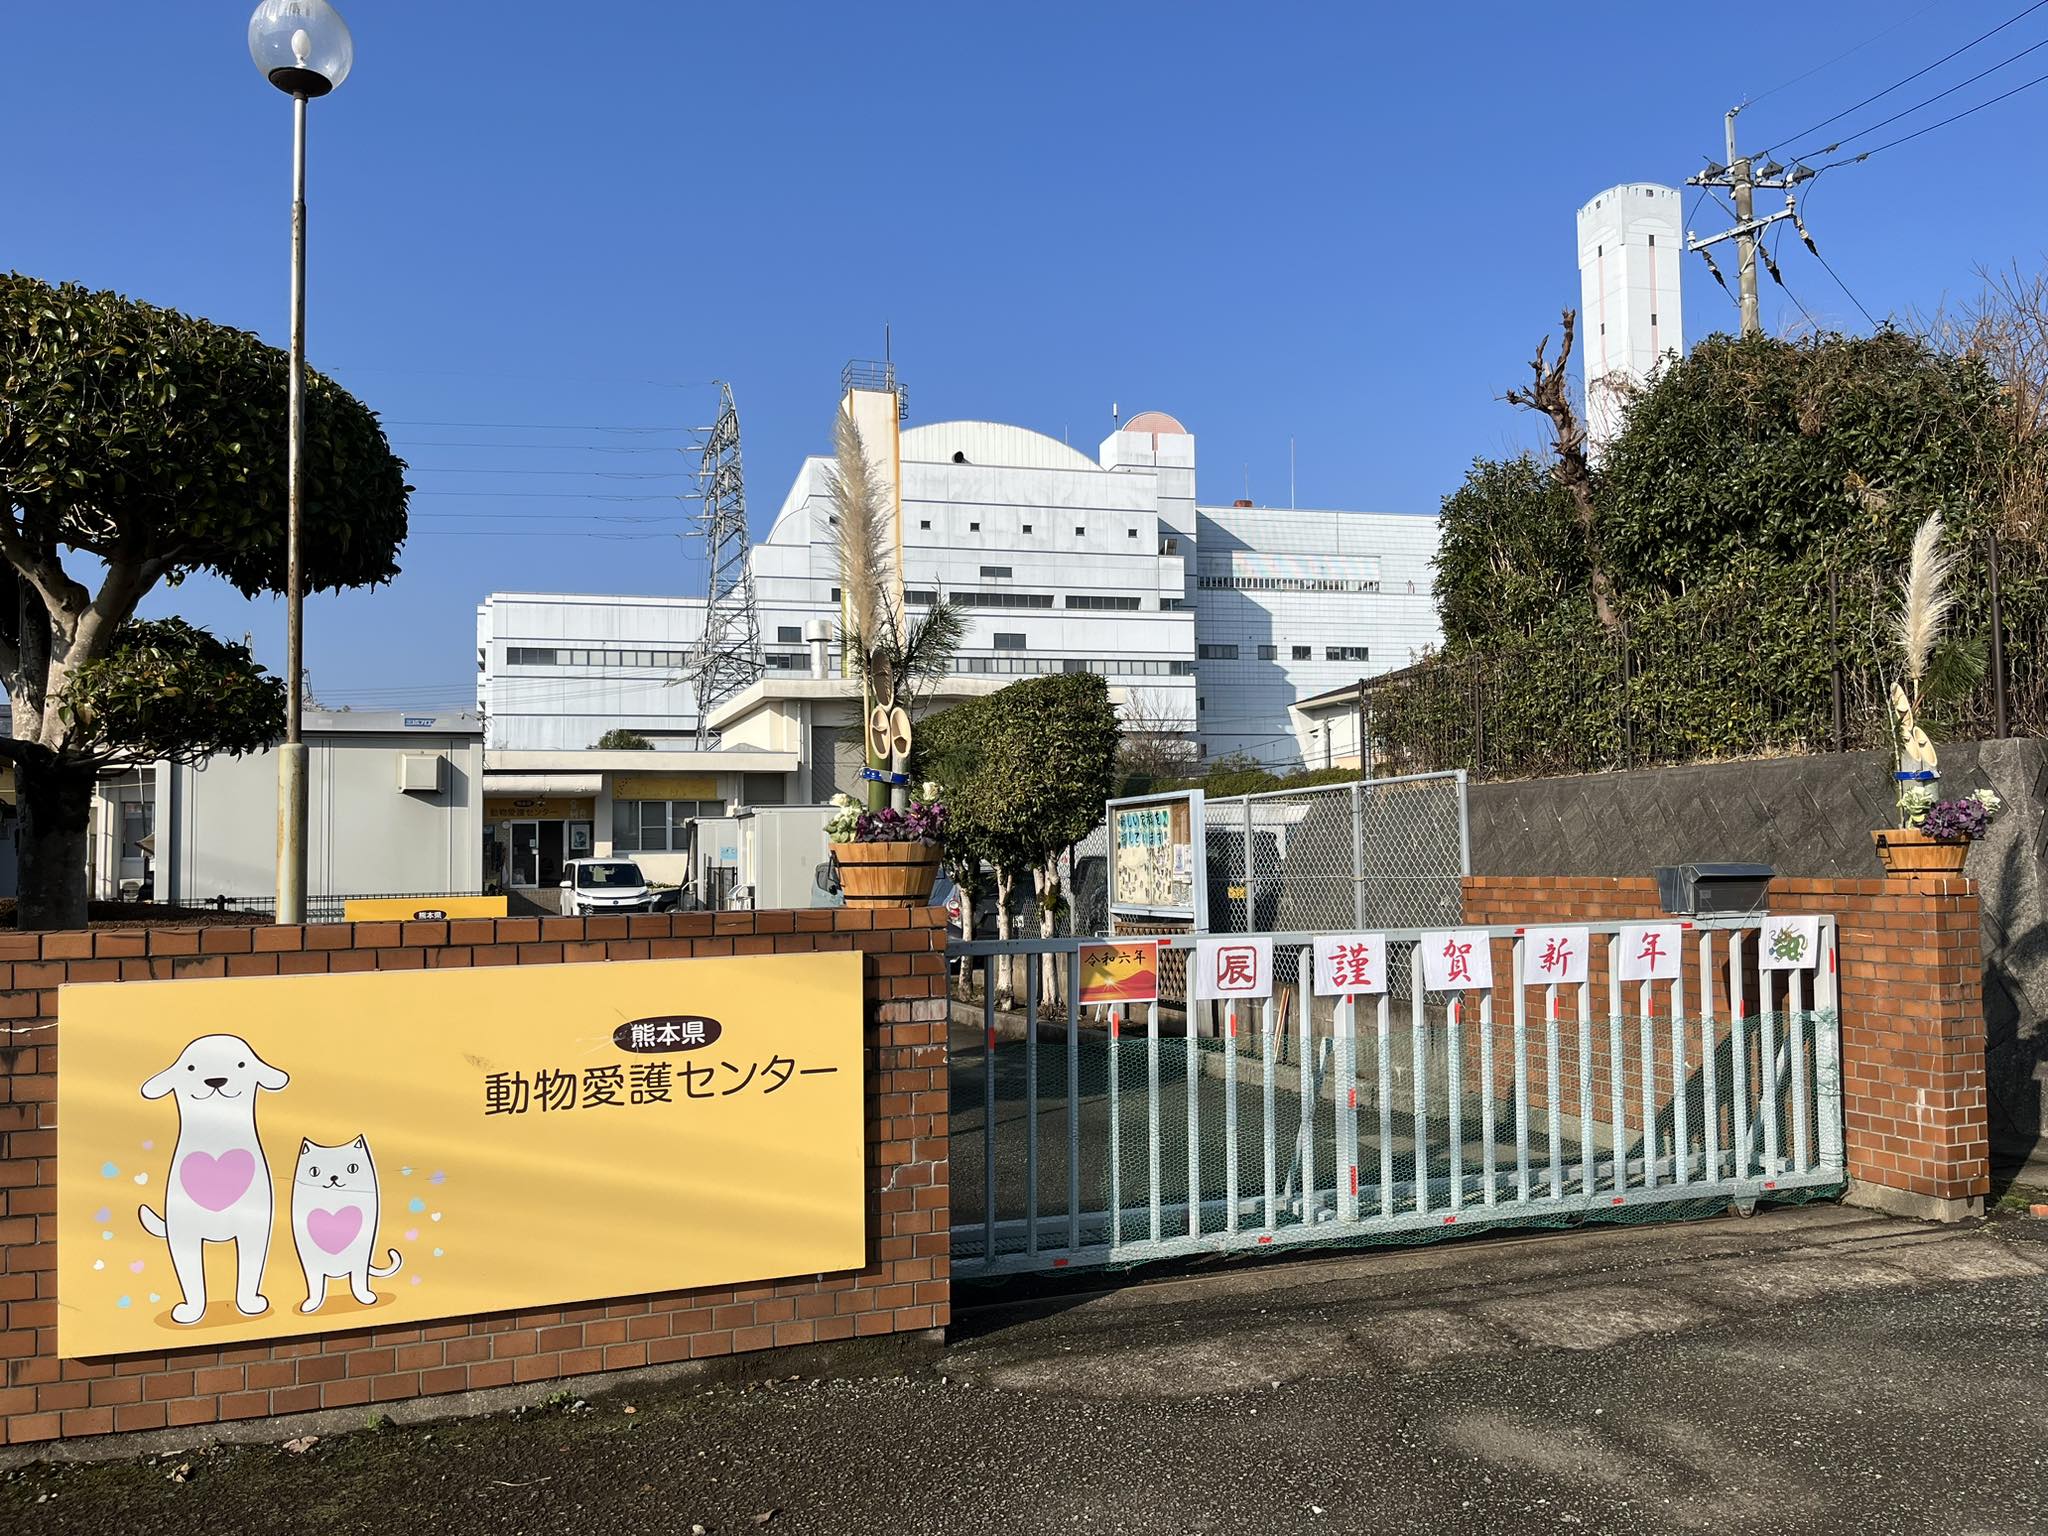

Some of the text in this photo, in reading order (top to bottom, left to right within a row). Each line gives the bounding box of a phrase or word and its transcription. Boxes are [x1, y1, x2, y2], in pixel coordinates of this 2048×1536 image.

[490, 807, 559, 817] 物センター
[1120, 831, 1163, 849] しています
[418, 911, 442, 920] 熊本県
[1084, 949, 1146, 967] 令和六年
[1217, 955, 1253, 983] 辰
[1327, 931, 1667, 988] 謹 賀 新 年
[630, 1020, 706, 1048] 熊本県
[484, 1054, 838, 1116] 動物愛護センター
